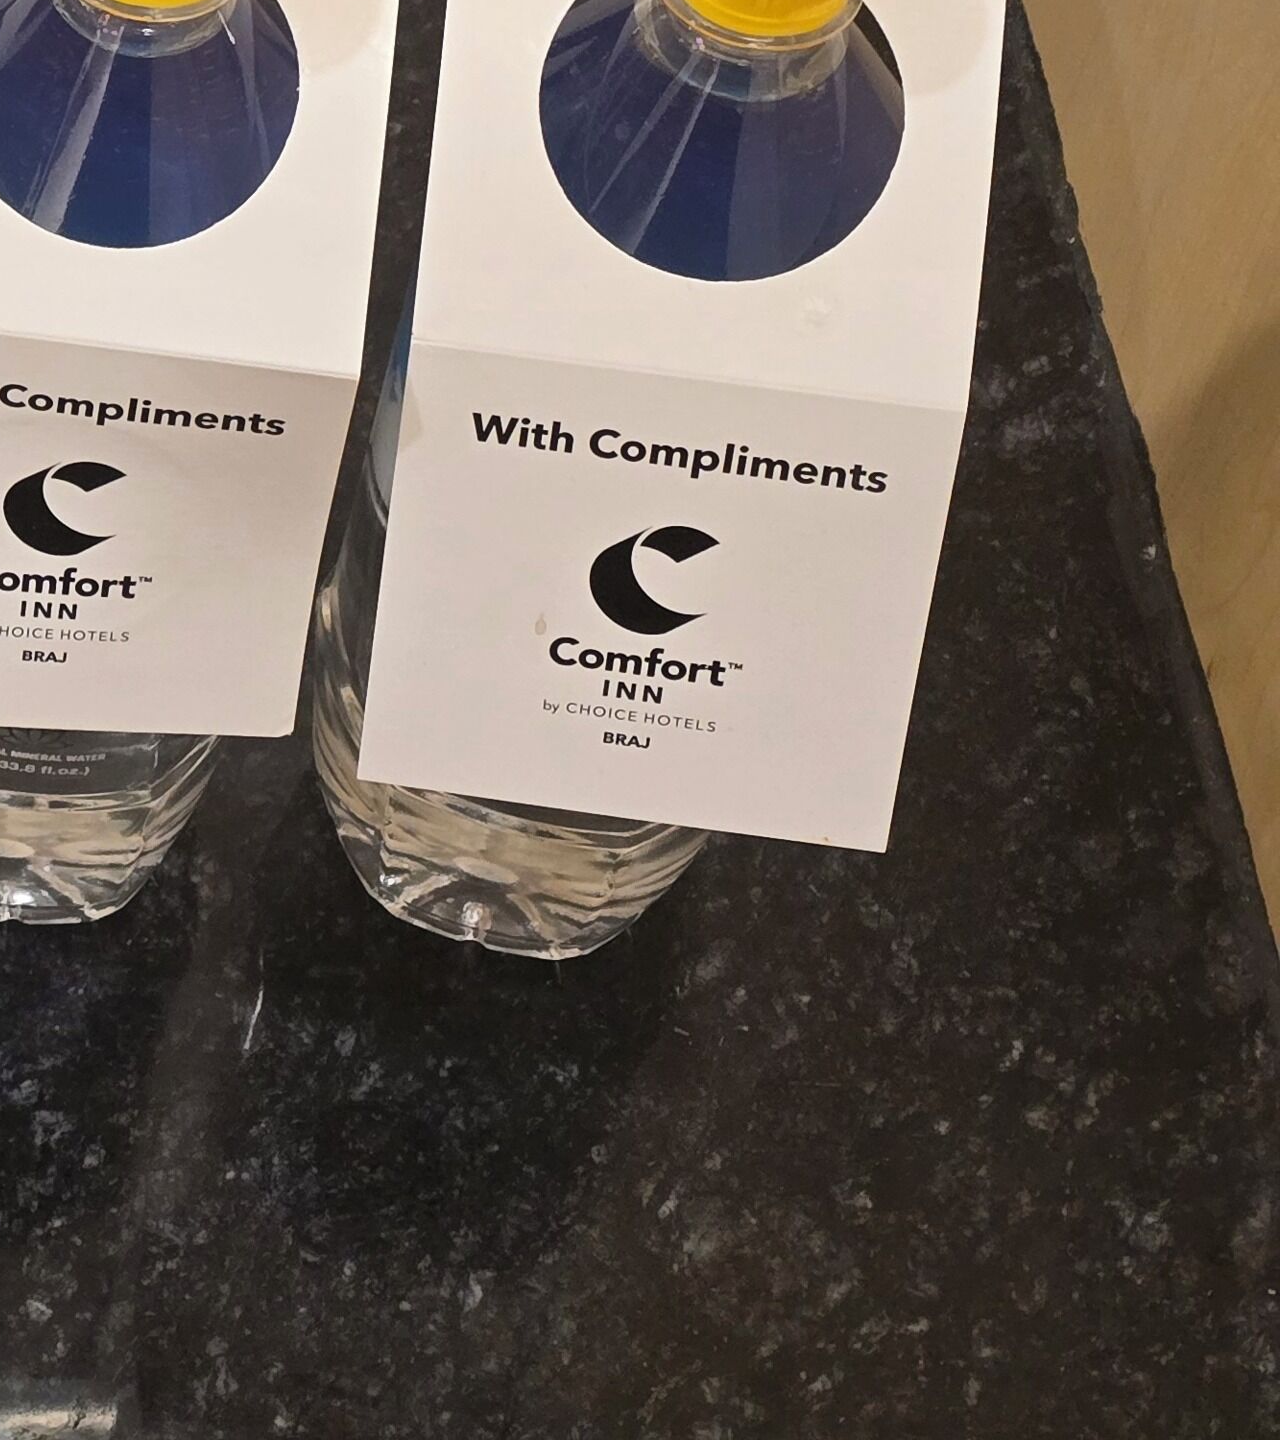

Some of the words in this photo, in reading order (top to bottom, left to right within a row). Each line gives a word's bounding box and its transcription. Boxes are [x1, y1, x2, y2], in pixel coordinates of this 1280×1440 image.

[472, 412, 574, 454] With
[589, 428, 888, 494] Compliments
[20, 600, 78, 620] INN
[60, 629, 130, 643] HOTELS
[21, 649, 68, 664] BRAJ
[602, 679, 664, 705] INN
[542, 698, 560, 715] by
[565, 702, 638, 723] CHOICE
[643, 712, 717, 733] HOTELS
[602, 731, 651, 749] BRAJ
[65, 752, 107, 763] WATER
